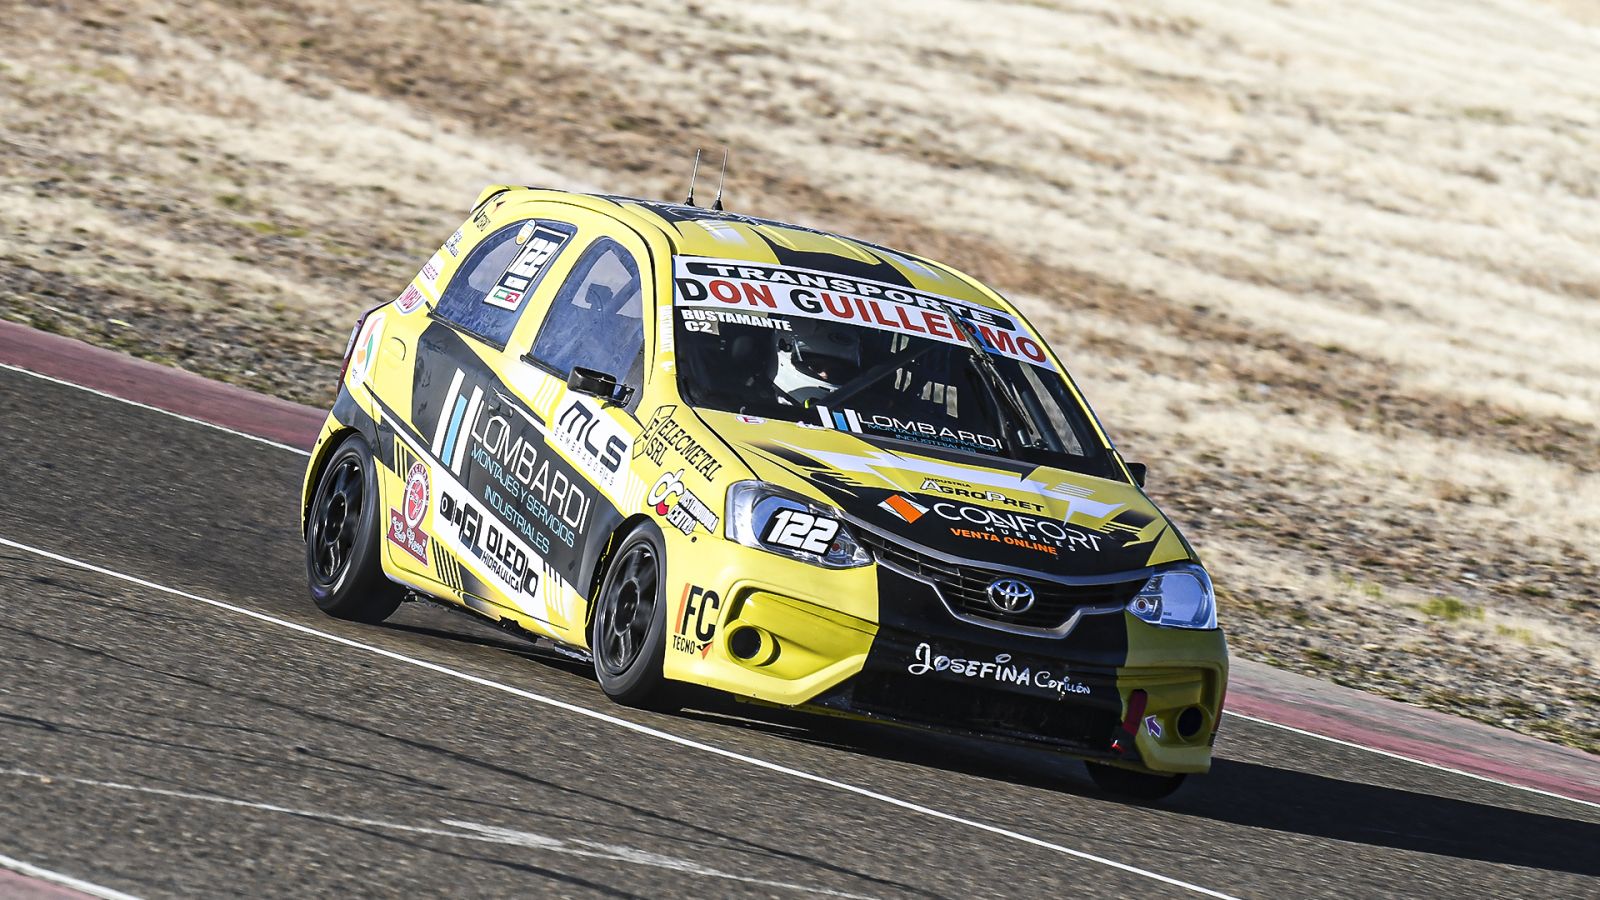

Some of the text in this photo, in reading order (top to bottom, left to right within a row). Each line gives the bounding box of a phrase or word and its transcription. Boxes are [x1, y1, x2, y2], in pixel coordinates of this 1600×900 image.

[675, 278, 777, 309] DON
[707, 264, 996, 324] TRANSPORTE
[680, 309, 793, 332] BUSTAMANTE
[684, 320, 714, 333] C2
[558, 400, 628, 473] MLS
[646, 437, 668, 467] SRL
[658, 419, 723, 482] ELECMETAL
[857, 412, 1003, 449] LOMBARDI
[471, 400, 591, 535] LOMBARDI
[924, 477, 972, 488] INDUSTRIA
[471, 443, 520, 498] MONTAJES
[521, 486, 531, 503] Y
[526, 495, 575, 548] SERVICIOS
[484, 485, 550, 554] INDUSTRIALES
[767, 510, 840, 554] 122
[933, 503, 1102, 551] CONFORT
[950, 527, 1058, 555] VENTA ONLINE
[984, 526, 1076, 551] MUEBLES
[481, 551, 521, 594] HIDRAULICA
[486, 525, 526, 577] OLEO
[673, 634, 696, 655] TECNO
